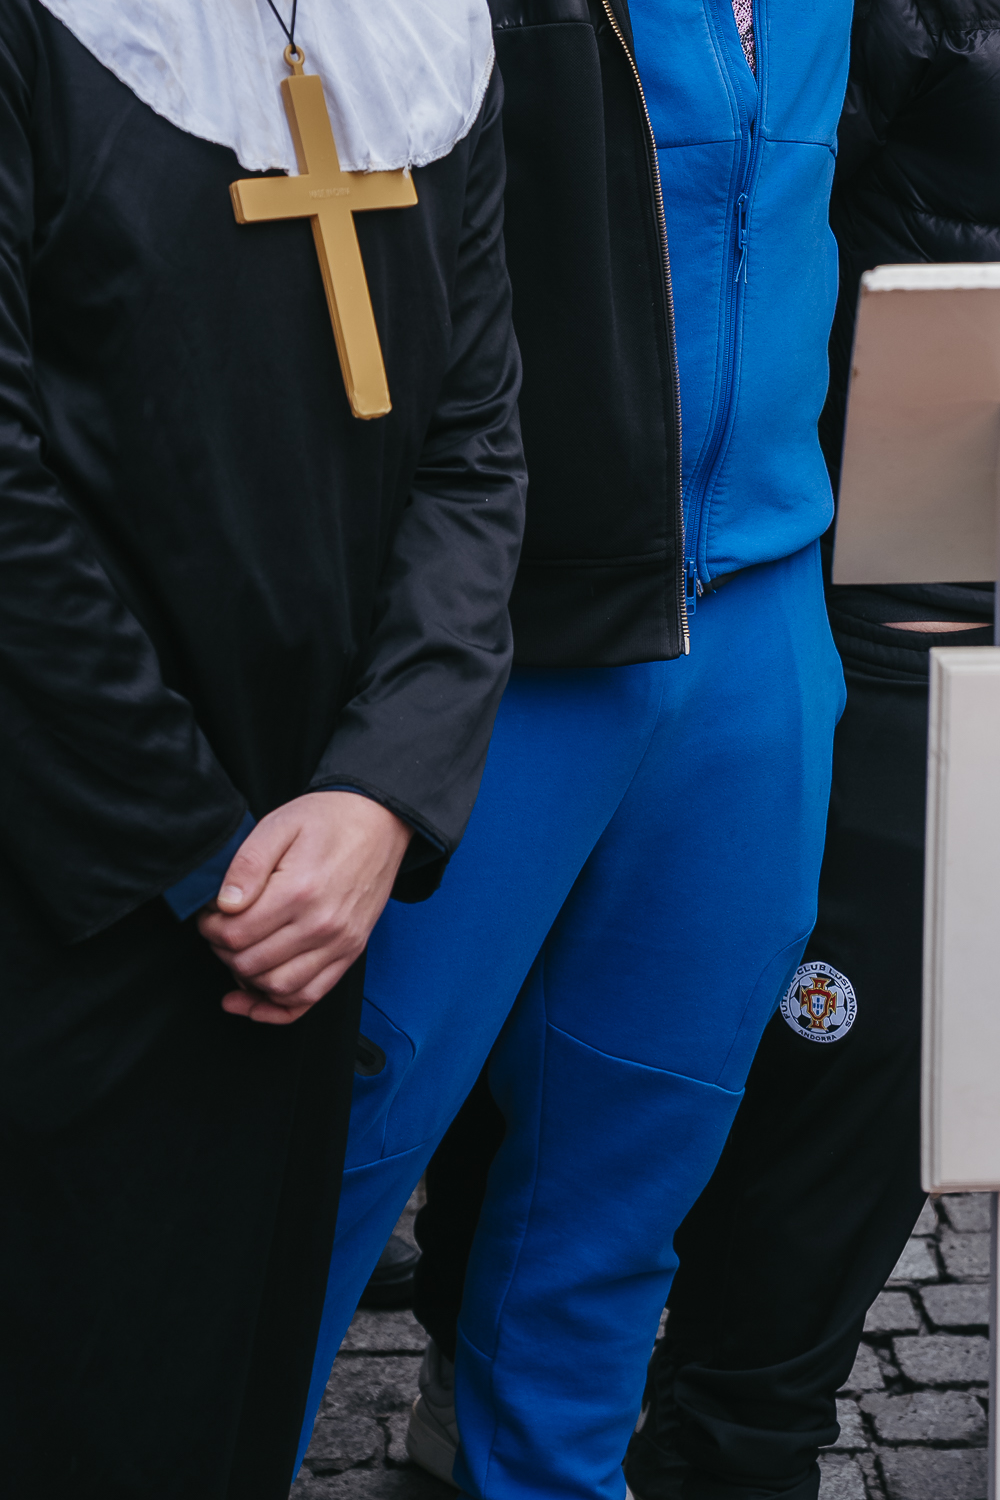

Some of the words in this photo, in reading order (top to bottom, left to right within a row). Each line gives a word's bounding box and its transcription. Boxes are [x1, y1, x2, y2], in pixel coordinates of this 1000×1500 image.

[796, 964, 826, 976] CLUB
[829, 968, 856, 1027] LUSITANOS
[798, 1029, 837, 1041] ANDORRA
